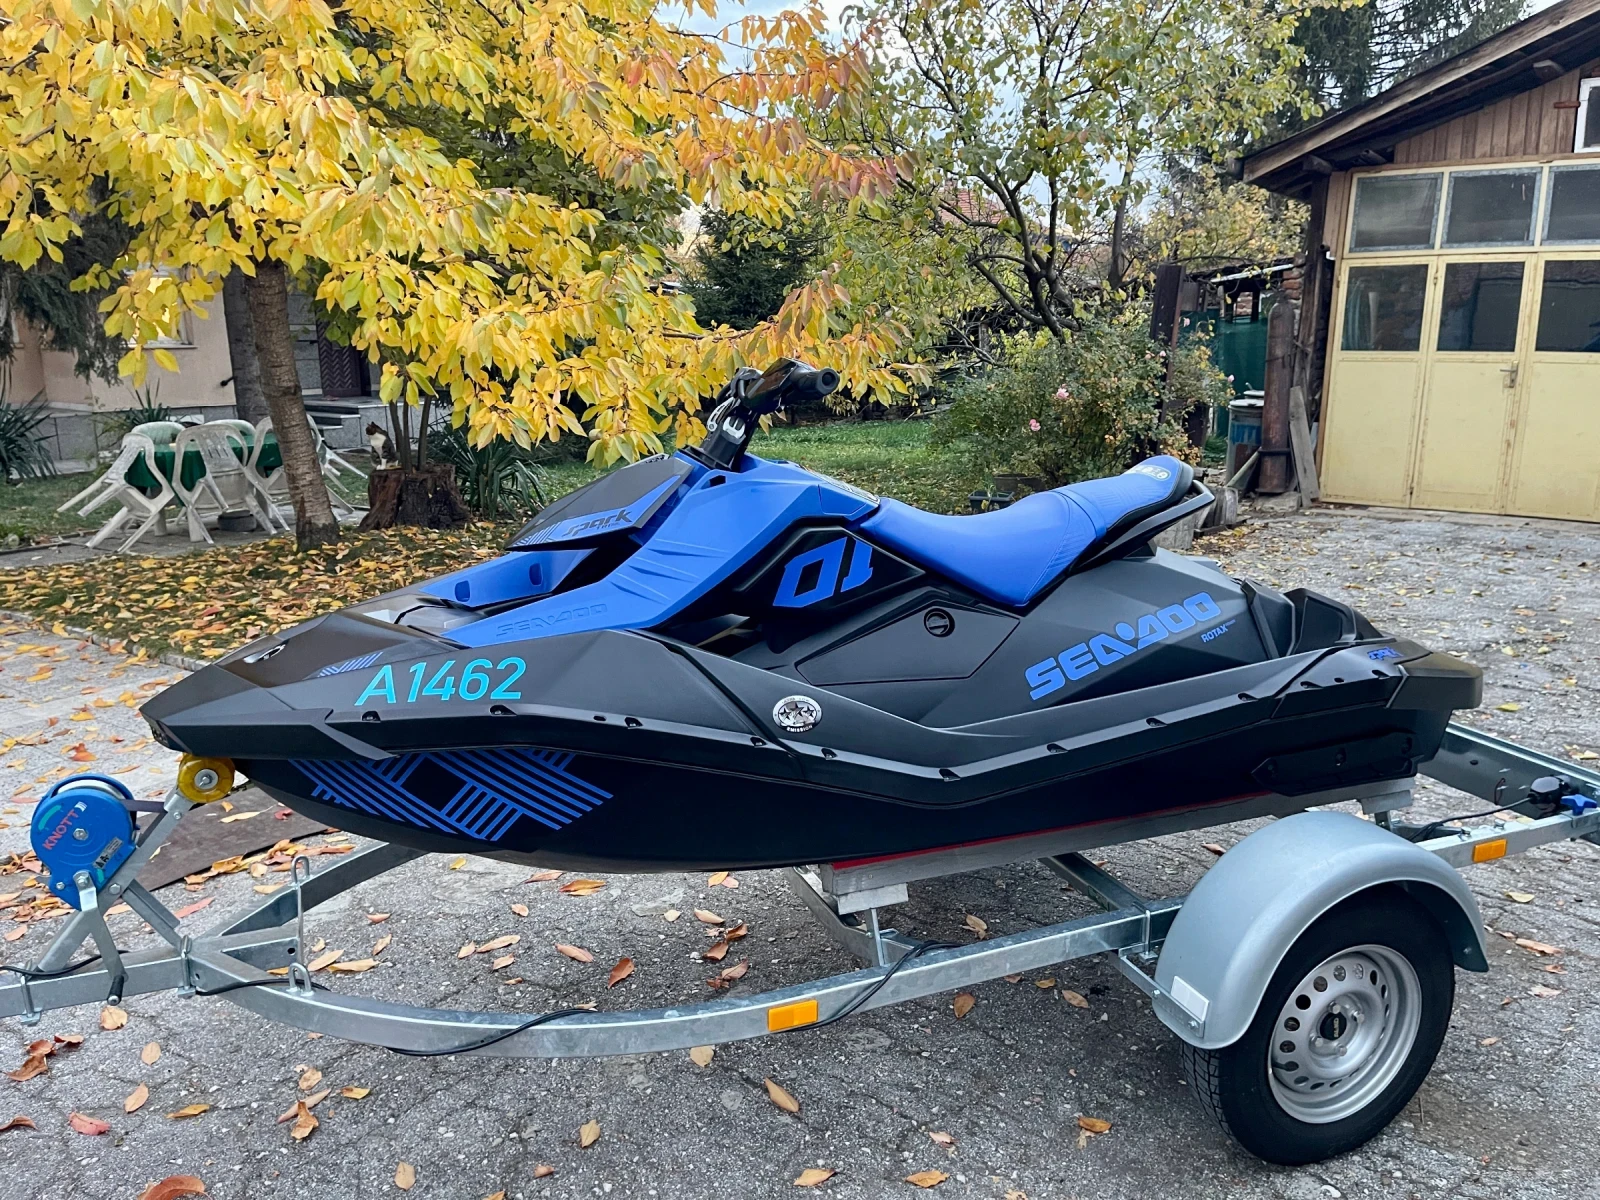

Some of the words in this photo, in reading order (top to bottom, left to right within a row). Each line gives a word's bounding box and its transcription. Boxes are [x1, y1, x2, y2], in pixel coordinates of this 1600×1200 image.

[1200, 623, 1229, 643] ROTAX
[407, 656, 527, 703] 1462
[42, 808, 79, 850] KNOTT
